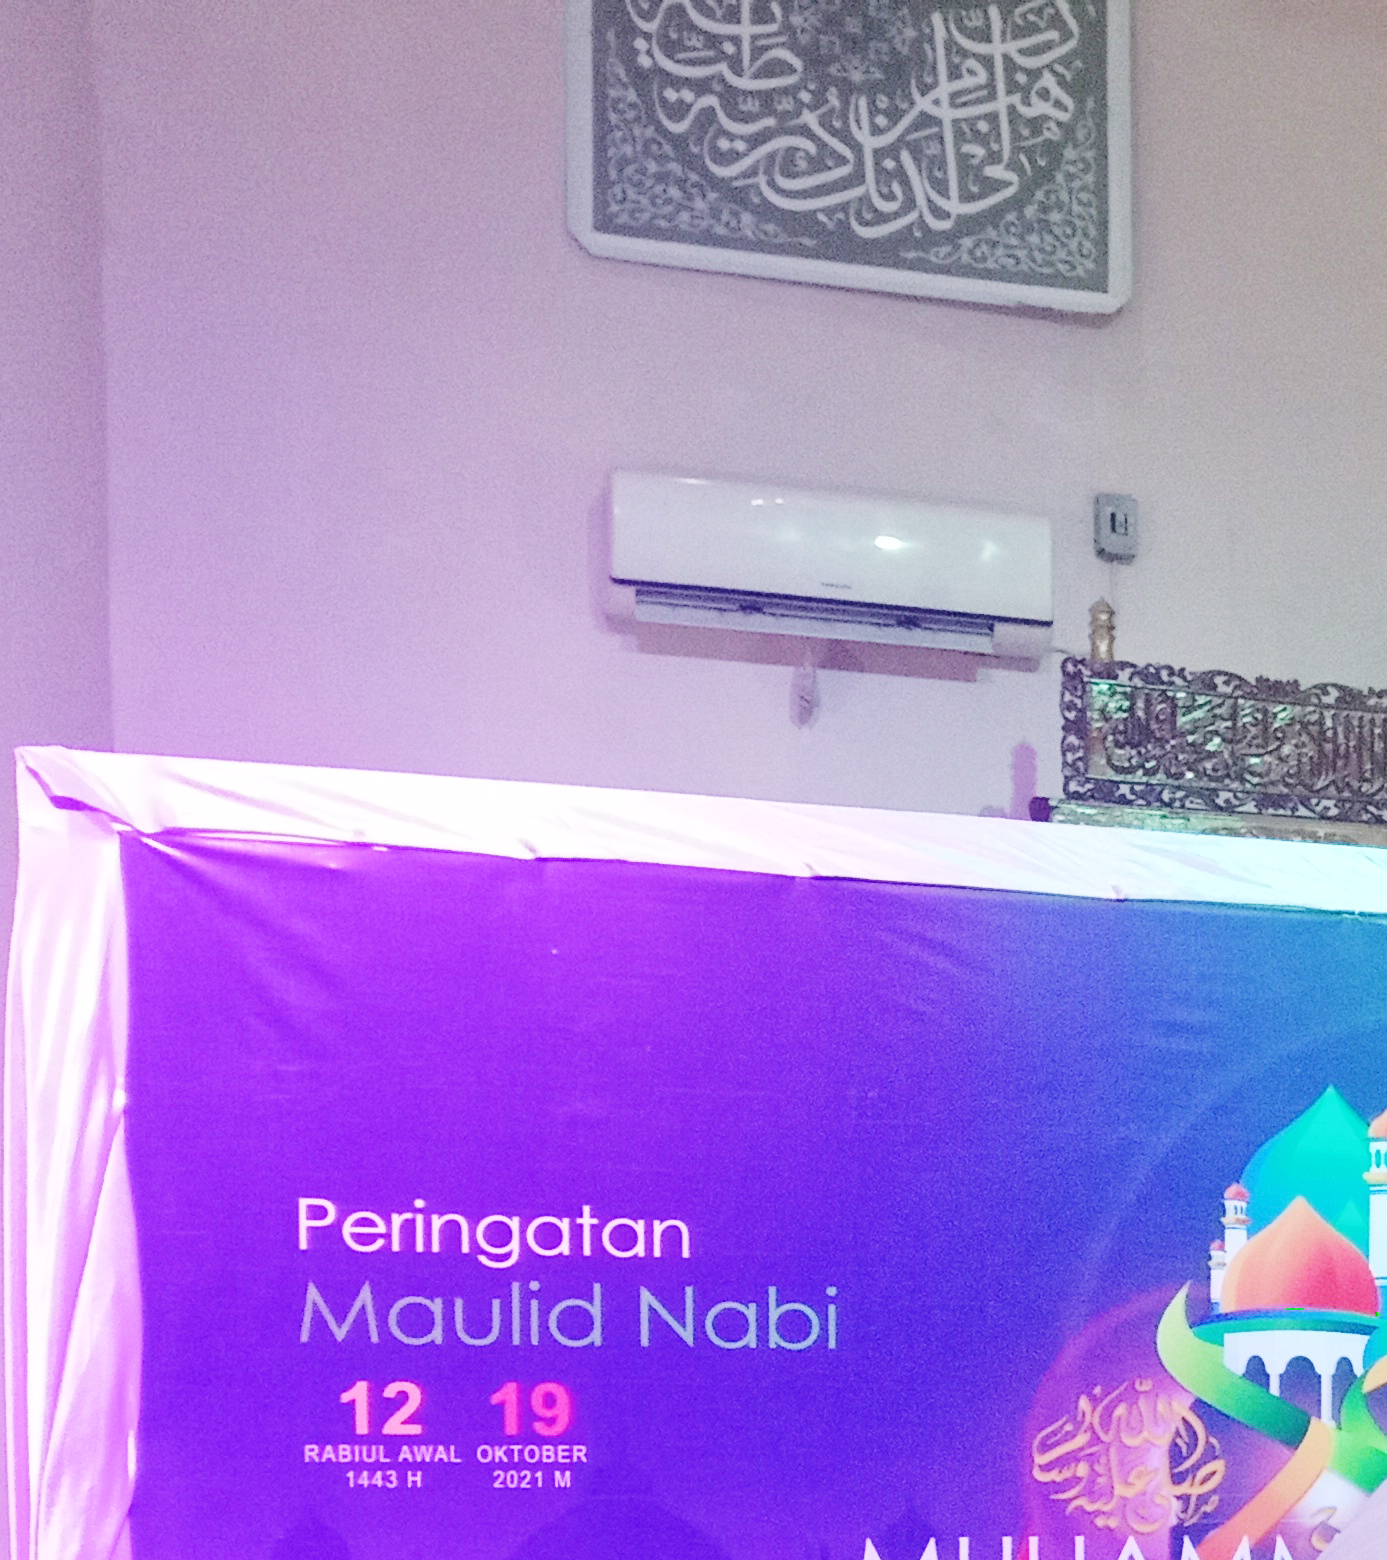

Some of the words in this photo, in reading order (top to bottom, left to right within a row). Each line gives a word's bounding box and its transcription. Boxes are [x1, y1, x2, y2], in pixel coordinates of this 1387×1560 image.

[298, 1197, 691, 1269] Peringatan
[299, 1280, 602, 1347] Maulid
[639, 1285, 838, 1351] Nabi
[340, 1380, 423, 1436] 12
[490, 1382, 572, 1437] 19
[304, 1444, 392, 1463] RABIUL
[398, 1445, 462, 1463] AWAL
[476, 1444, 589, 1464] OKTOBER
[346, 1469, 399, 1489] 1443
[406, 1470, 423, 1488] H
[492, 1469, 544, 1489] 2021
[554, 1470, 572, 1488] M
